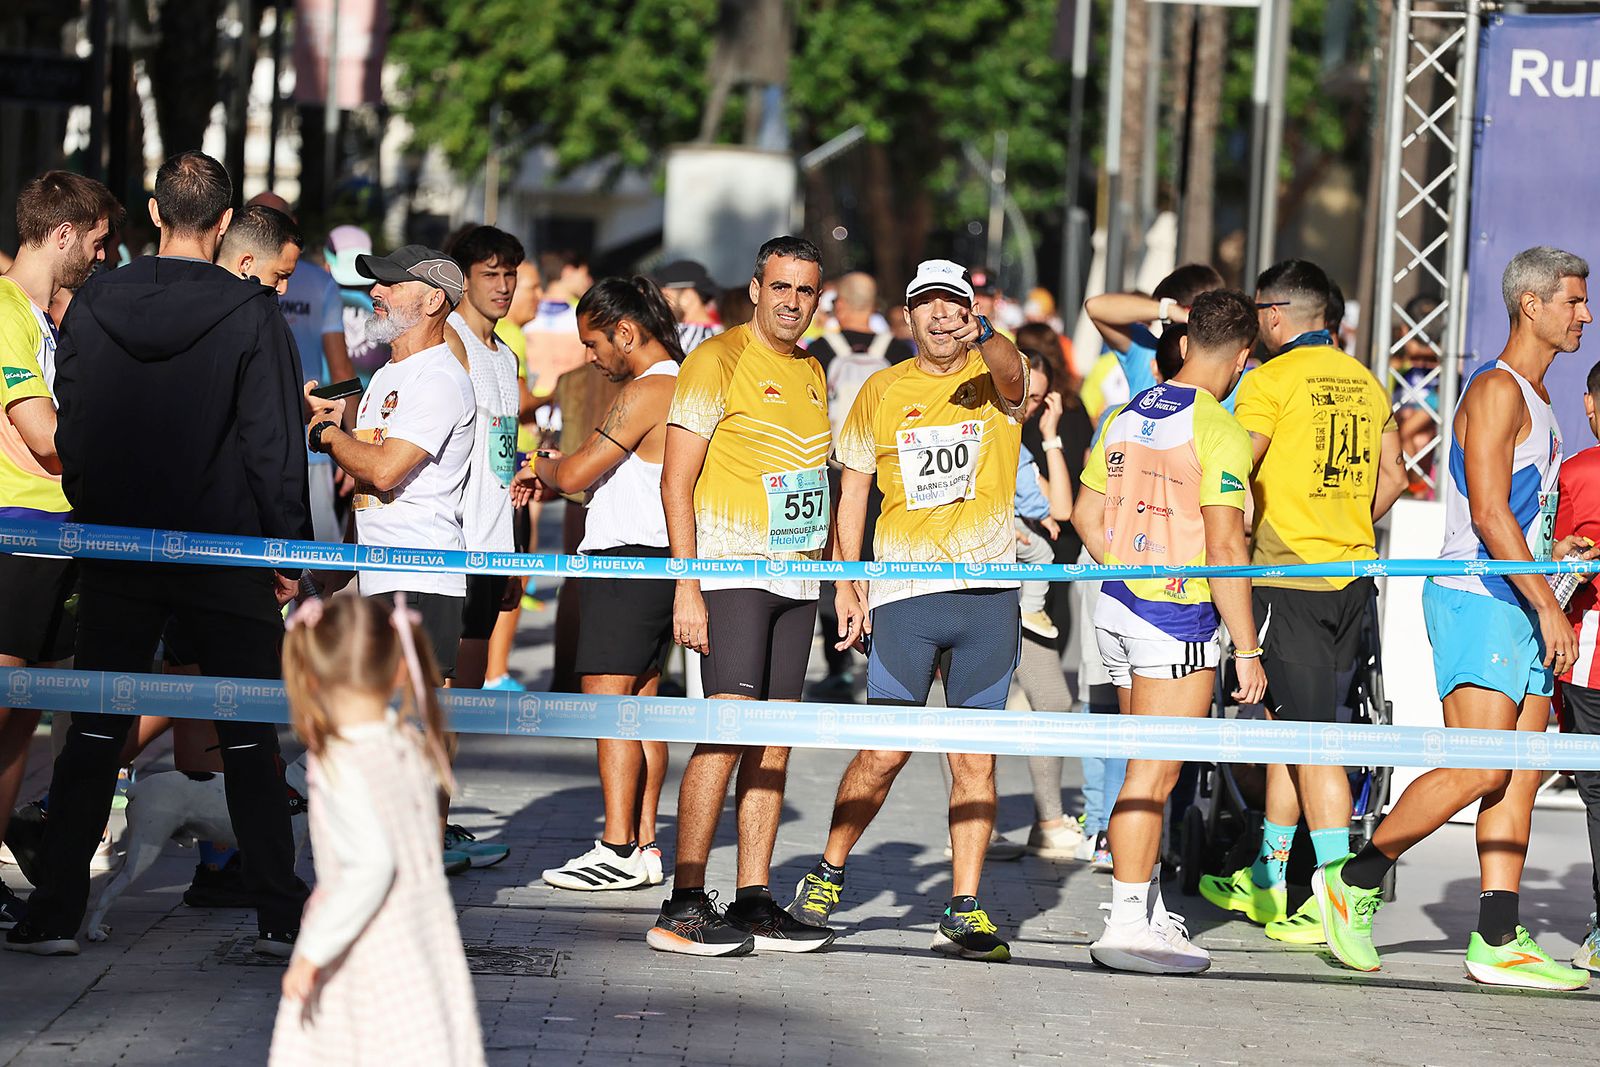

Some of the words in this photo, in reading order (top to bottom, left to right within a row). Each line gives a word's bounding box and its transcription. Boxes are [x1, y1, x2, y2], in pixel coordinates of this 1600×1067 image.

[1316, 427, 1326, 435] THE
[918, 443, 969, 477] 200
[770, 474, 789, 488] 21K
[917, 481, 949, 492] BARNES
[949, 474, 971, 487] LOPEZ
[785, 490, 824, 520] 557
[770, 534, 807, 545] Huelva
[86, 539, 140, 553] HUELVA
[190, 545, 242, 556] HUELVA
[290, 550, 344, 562] HUELVA
[392, 554, 446, 565] HUELVA
[492, 558, 545, 569] HUELVA
[592, 560, 646, 571] HUELVA
[691, 562, 745, 572] HUELVA
[791, 563, 845, 573] HUELVA
[890, 564, 943, 573] HUELVA
[990, 564, 1044, 572] HUELVA
